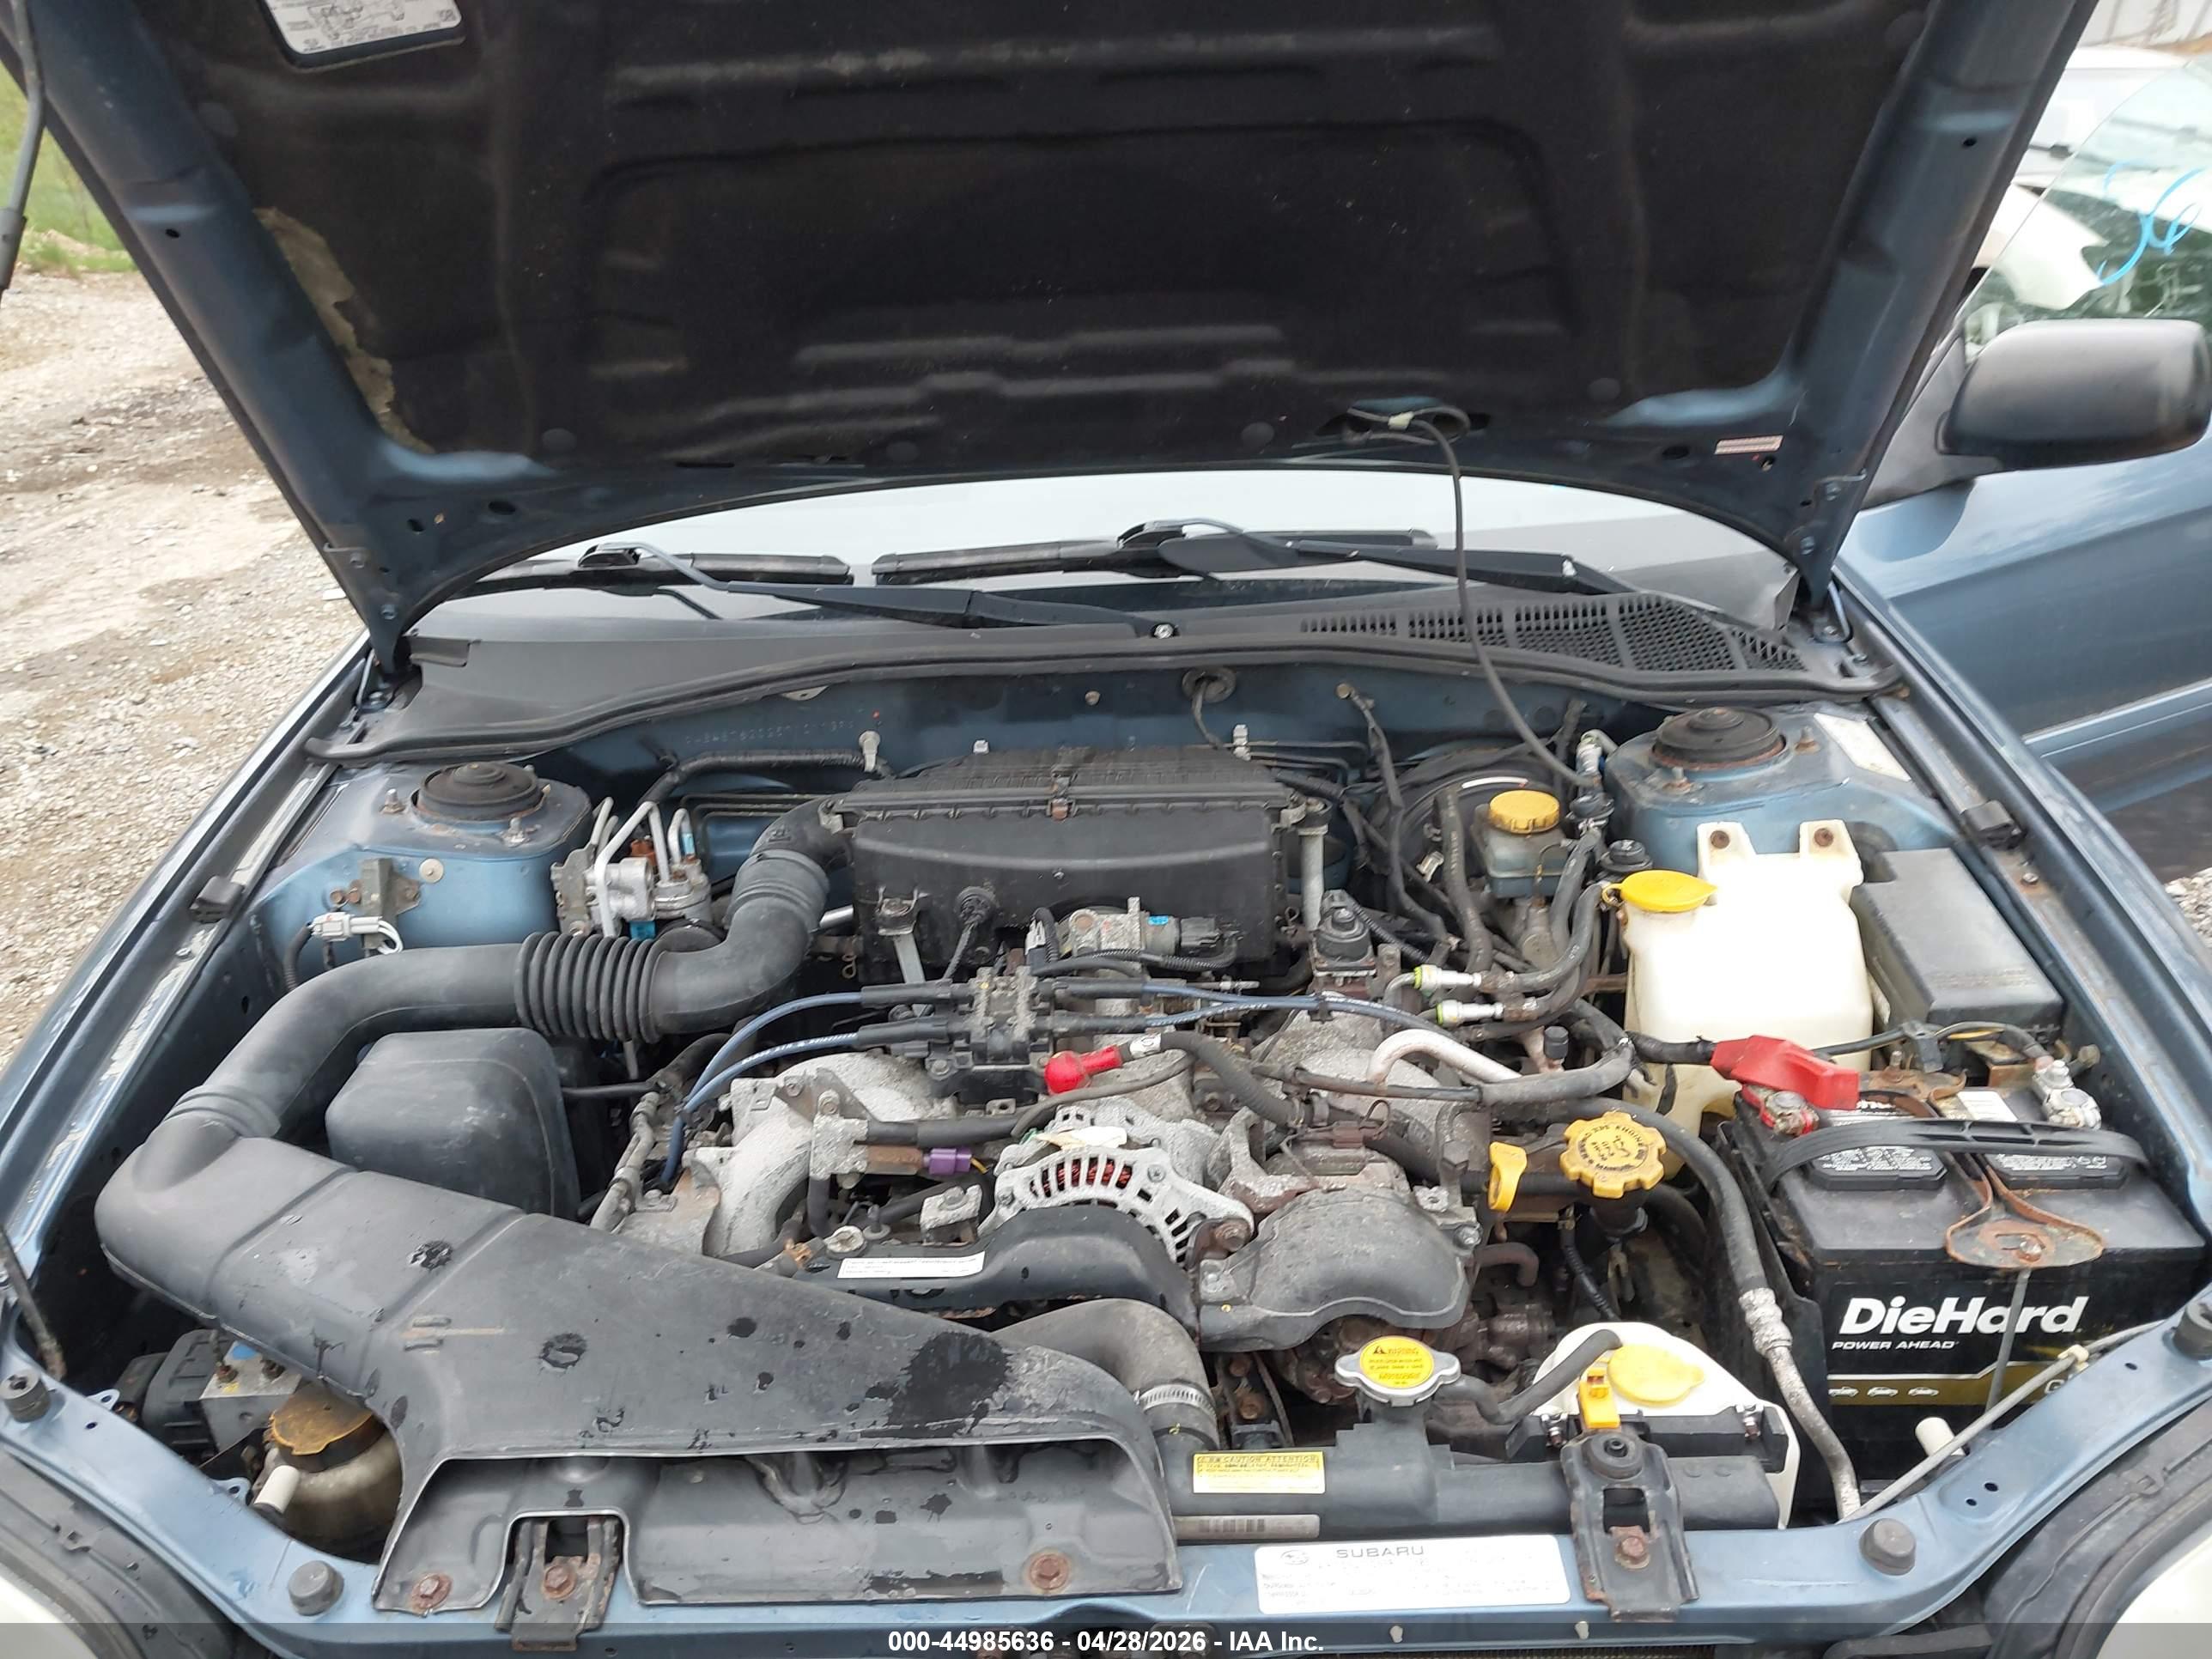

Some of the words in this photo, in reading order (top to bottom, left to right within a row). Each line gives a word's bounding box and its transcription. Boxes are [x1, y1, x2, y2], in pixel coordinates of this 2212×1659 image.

[1839, 1295, 2089, 1334] DieHard
[1832, 1340, 1893, 1350] POWER
[1895, 1340, 1955, 1350] AHEAD
[1336, 1546, 1424, 1559] SUBARU
